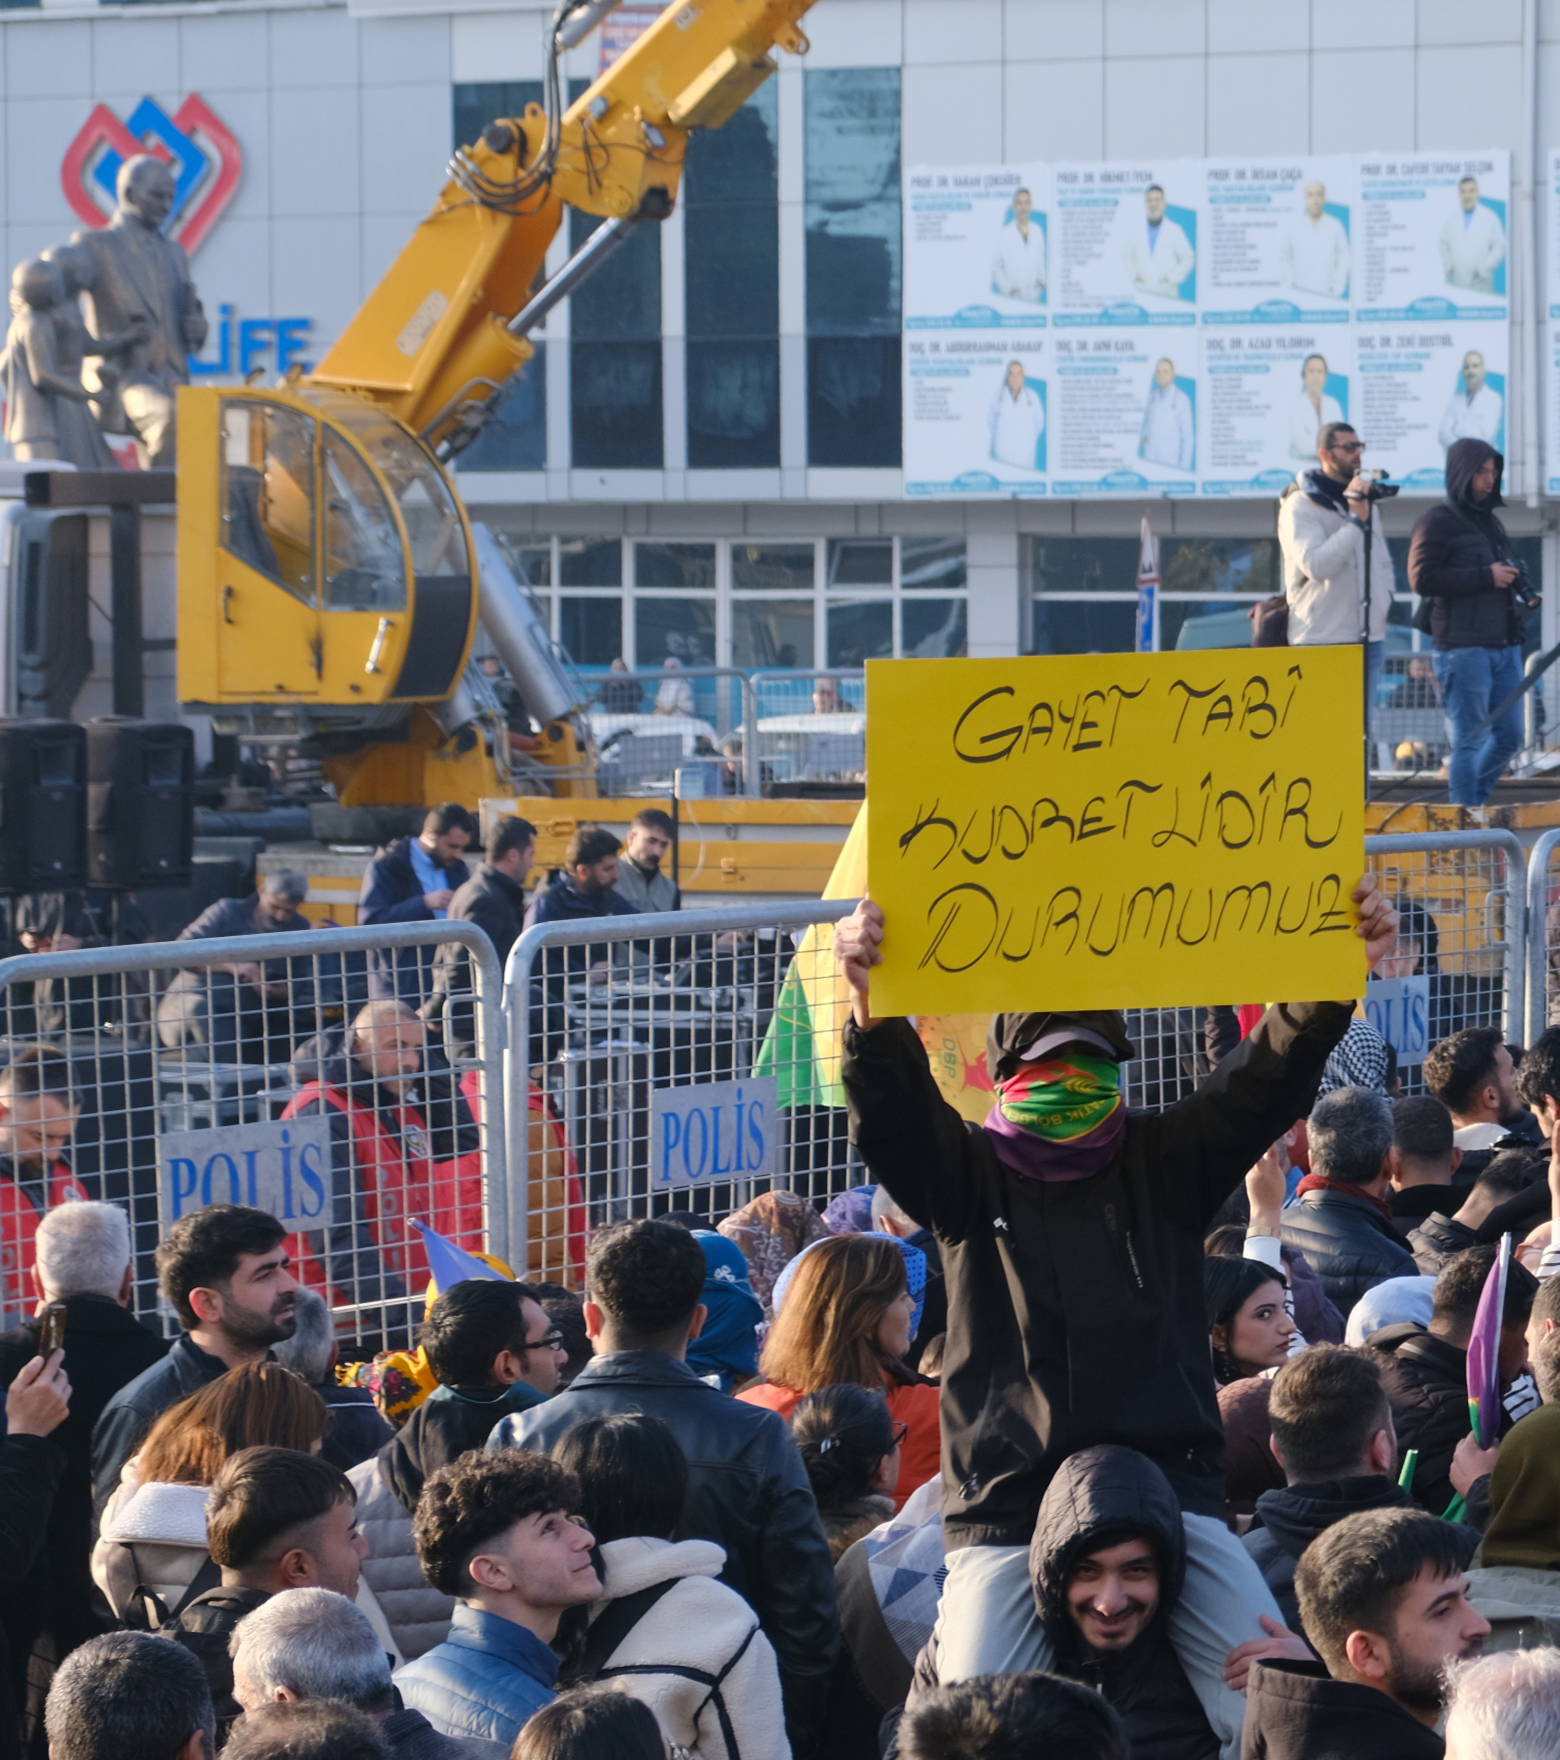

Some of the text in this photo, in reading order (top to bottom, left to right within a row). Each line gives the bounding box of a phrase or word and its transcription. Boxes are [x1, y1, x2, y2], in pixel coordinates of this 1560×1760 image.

[953, 678, 1150, 763] GAYET
[918, 873, 1351, 973] DURUMUMUZ
[943, 1037, 957, 1079] DBP
[1366, 984, 1425, 1053] OLİS
[166, 1129, 325, 1221] POLİS
[661, 1087, 765, 1182] POLİS
